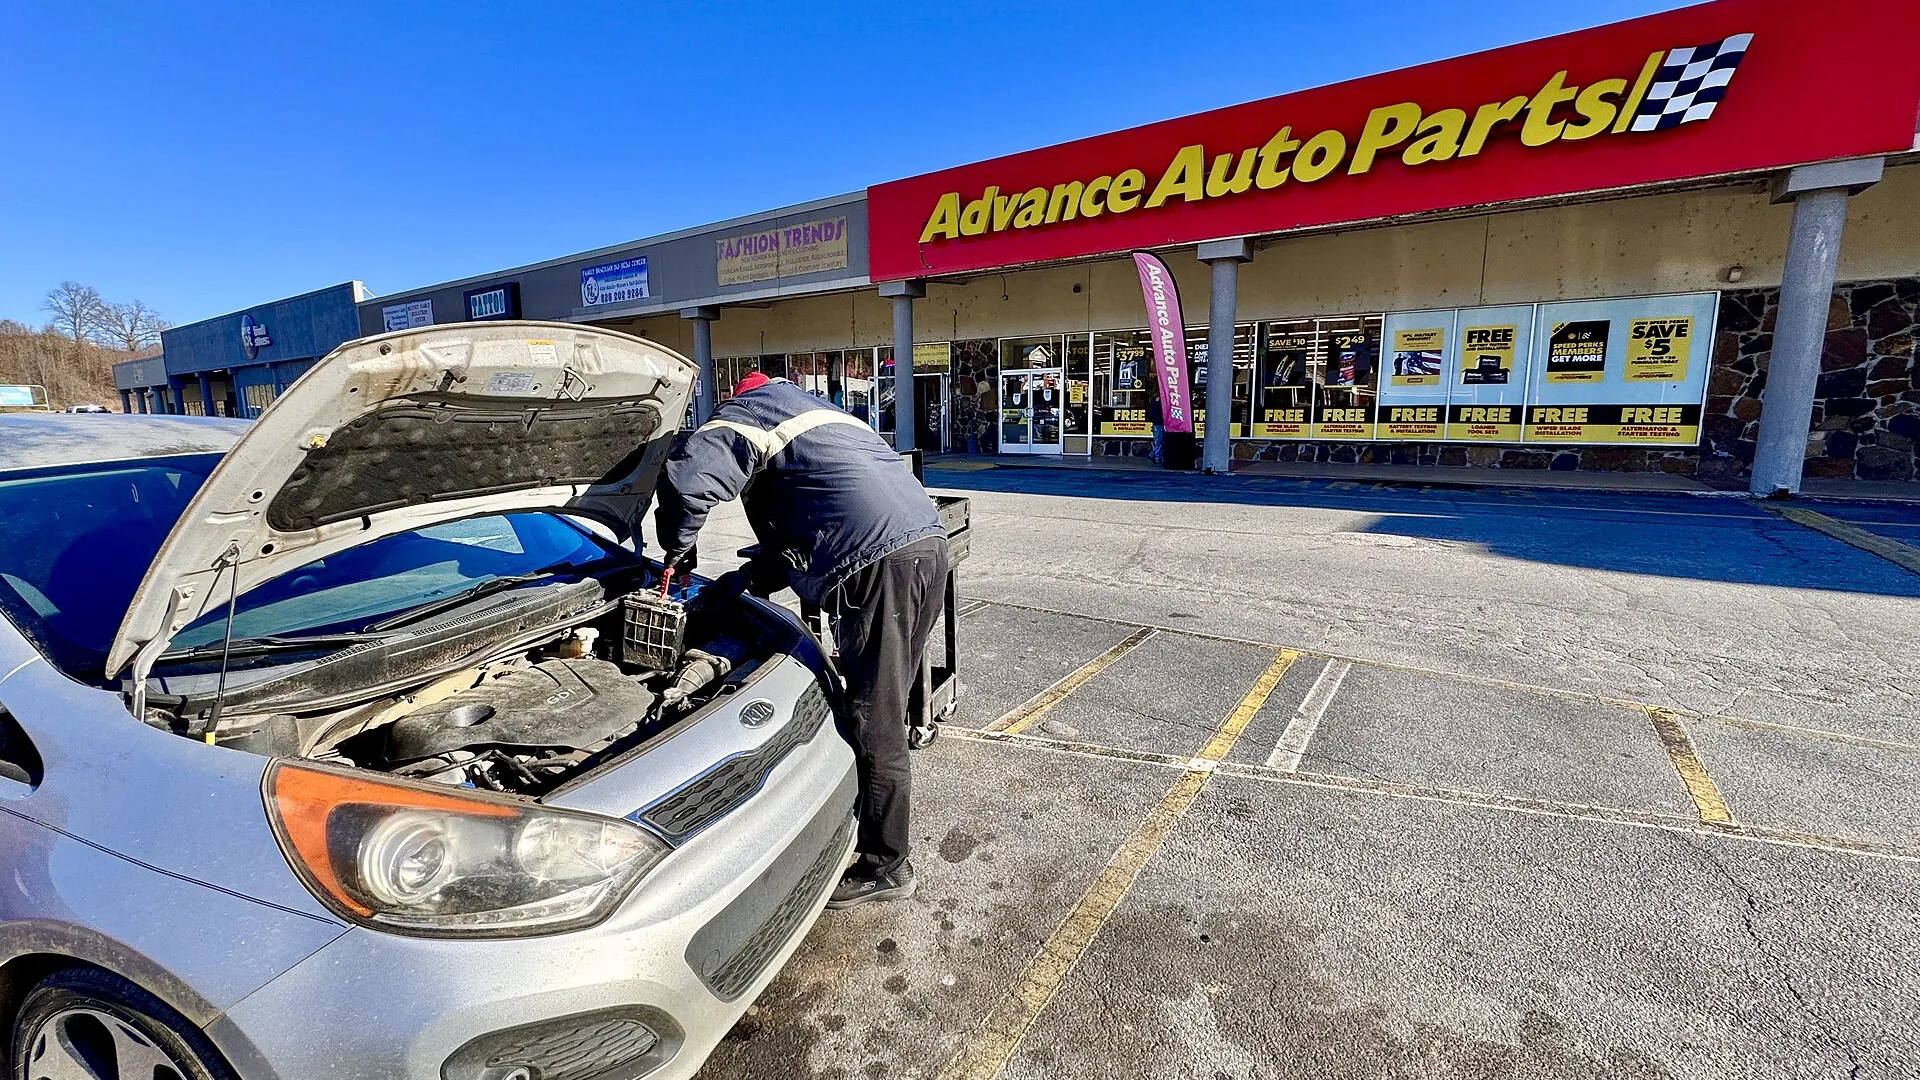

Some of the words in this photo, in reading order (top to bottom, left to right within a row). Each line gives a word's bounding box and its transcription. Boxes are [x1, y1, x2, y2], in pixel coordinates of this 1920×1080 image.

[918, 169, 1146, 244] Advance
[1144, 125, 1348, 210] Auto
[1346, 69, 1628, 177] Parts
[717, 232, 779, 261] FASHION
[784, 219, 845, 249] TRENDS
[1146, 262, 1170, 327] Advance
[472, 289, 504, 317] TATTOO
[1552, 322, 1565, 333] NEW
[1631, 324, 1689, 339] SAVE
[1269, 339, 1292, 347] SAVE
[1467, 328, 1514, 343] FREE
[1160, 326, 1177, 365] Auto
[1552, 347, 1604, 356] MEMBERS
[1644, 338, 1671, 355] $5
[1551, 355, 1572, 363] GET
[1572, 354, 1603, 362] MORE
[1166, 365, 1183, 407] Parts
[1114, 409, 1146, 421] FREE
[1264, 409, 1304, 422] FREE
[1322, 408, 1365, 422] FREE
[1391, 408, 1438, 422] FREE
[1459, 408, 1511, 423] FREE
[1532, 407, 1589, 423] FREE
[1620, 407, 1683, 423] FREE
[546, 689, 576, 705] GDI
[743, 703, 773, 725] KIA
